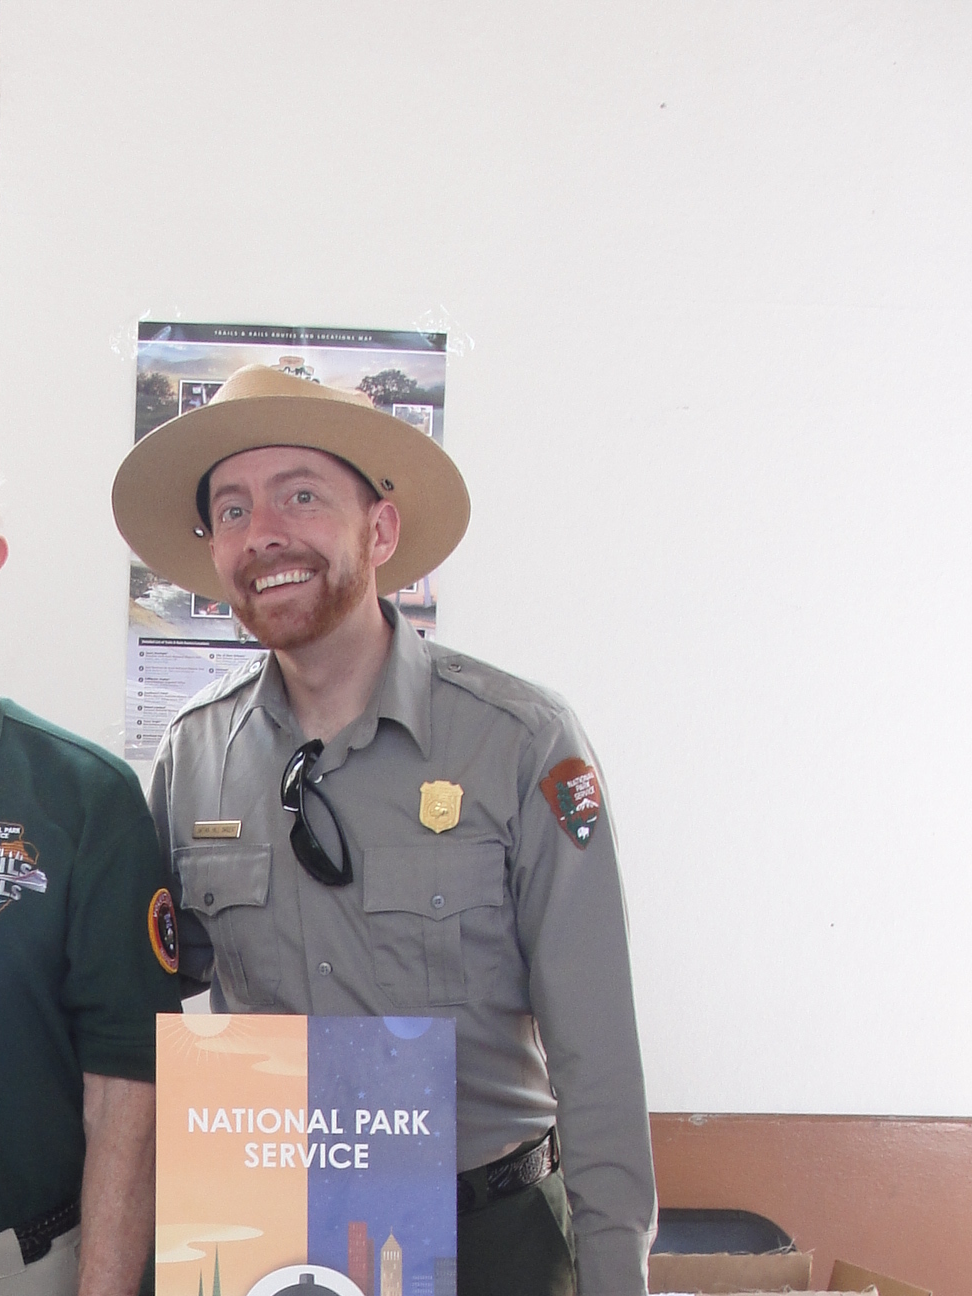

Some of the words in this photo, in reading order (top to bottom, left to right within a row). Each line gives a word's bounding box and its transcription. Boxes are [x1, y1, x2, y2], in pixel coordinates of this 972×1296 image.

[316, 333, 355, 341] LOCATIONS
[187, 1107, 344, 1135] NATIONAL
[355, 1109, 431, 1136] PARK
[244, 1142, 370, 1169] SERVICE
